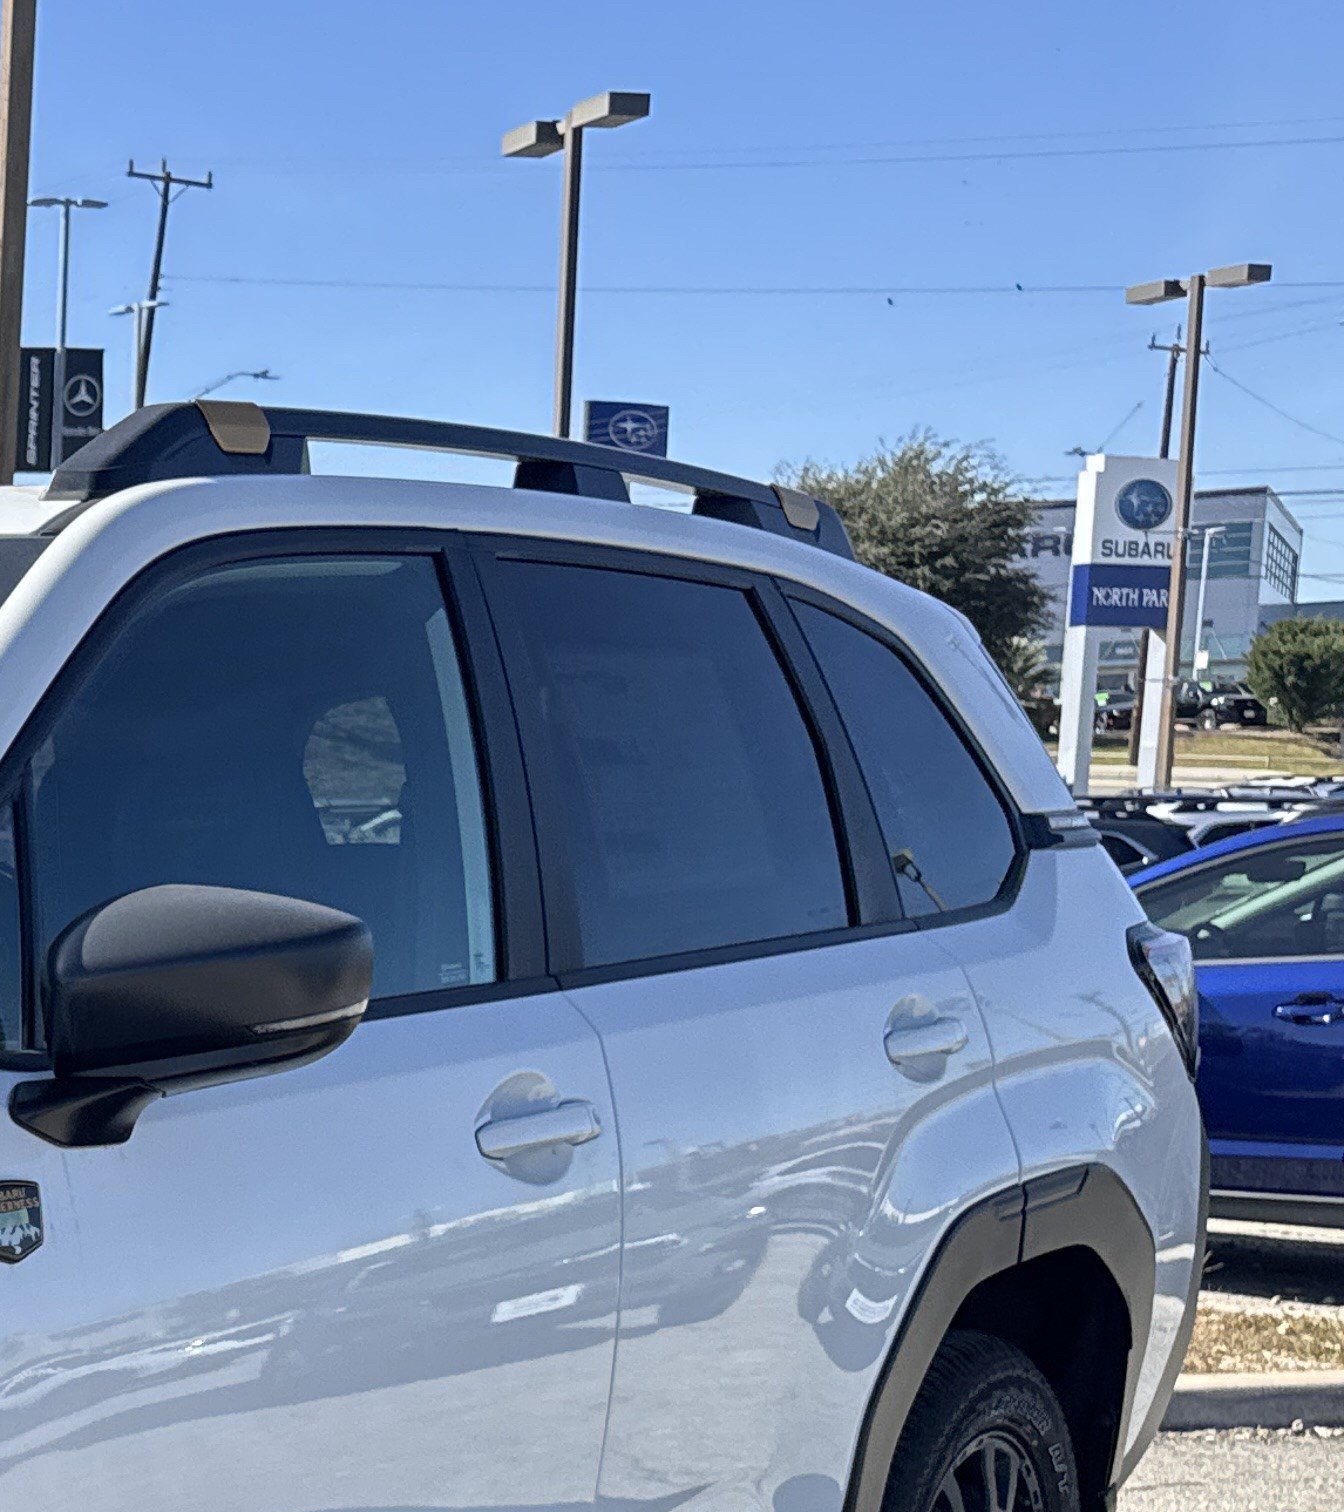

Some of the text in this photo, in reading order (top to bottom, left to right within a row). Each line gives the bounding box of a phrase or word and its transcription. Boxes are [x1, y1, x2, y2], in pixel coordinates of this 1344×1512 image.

[26, 356, 41, 466] SPRINTER
[1092, 586, 1169, 608] NORTH PAR
